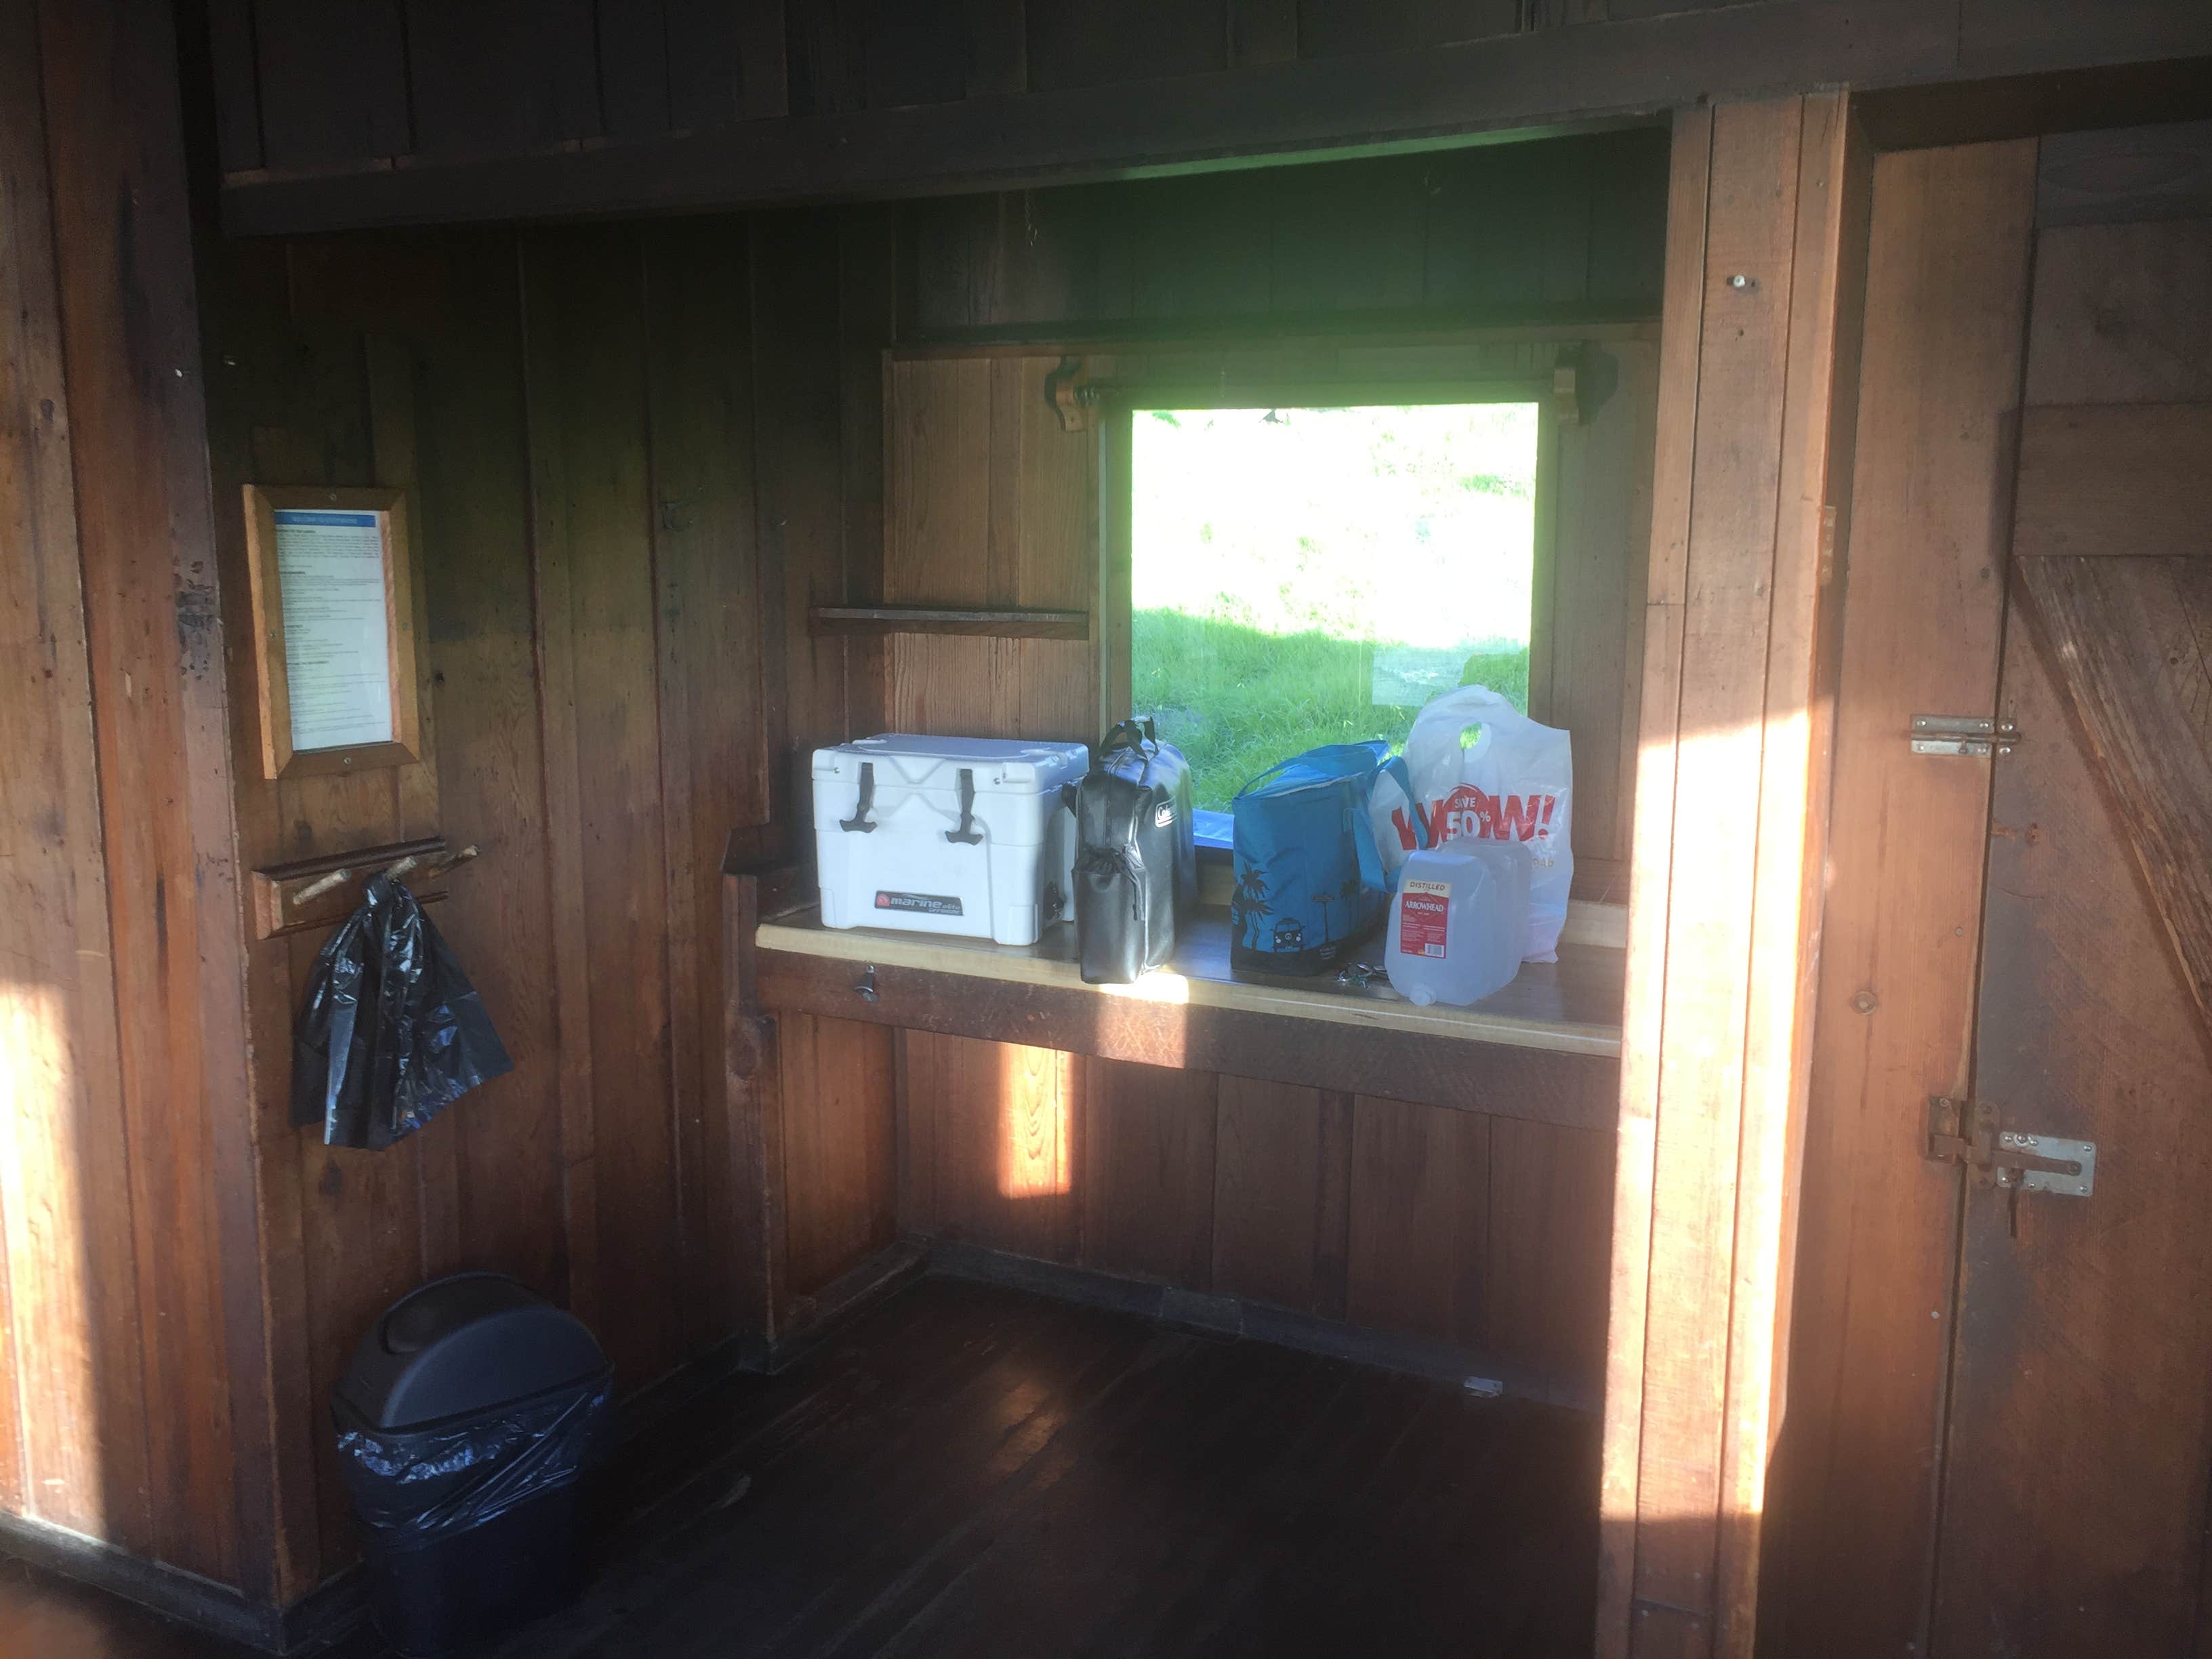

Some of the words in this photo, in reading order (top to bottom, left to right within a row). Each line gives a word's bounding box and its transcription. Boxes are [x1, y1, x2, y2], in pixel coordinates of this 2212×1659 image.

[1454, 796, 1477, 808] SAVE
[1410, 881, 1446, 891] DISTILLED
[890, 897, 943, 909] marine
[1405, 900, 1444, 912] ARROWHEAD
